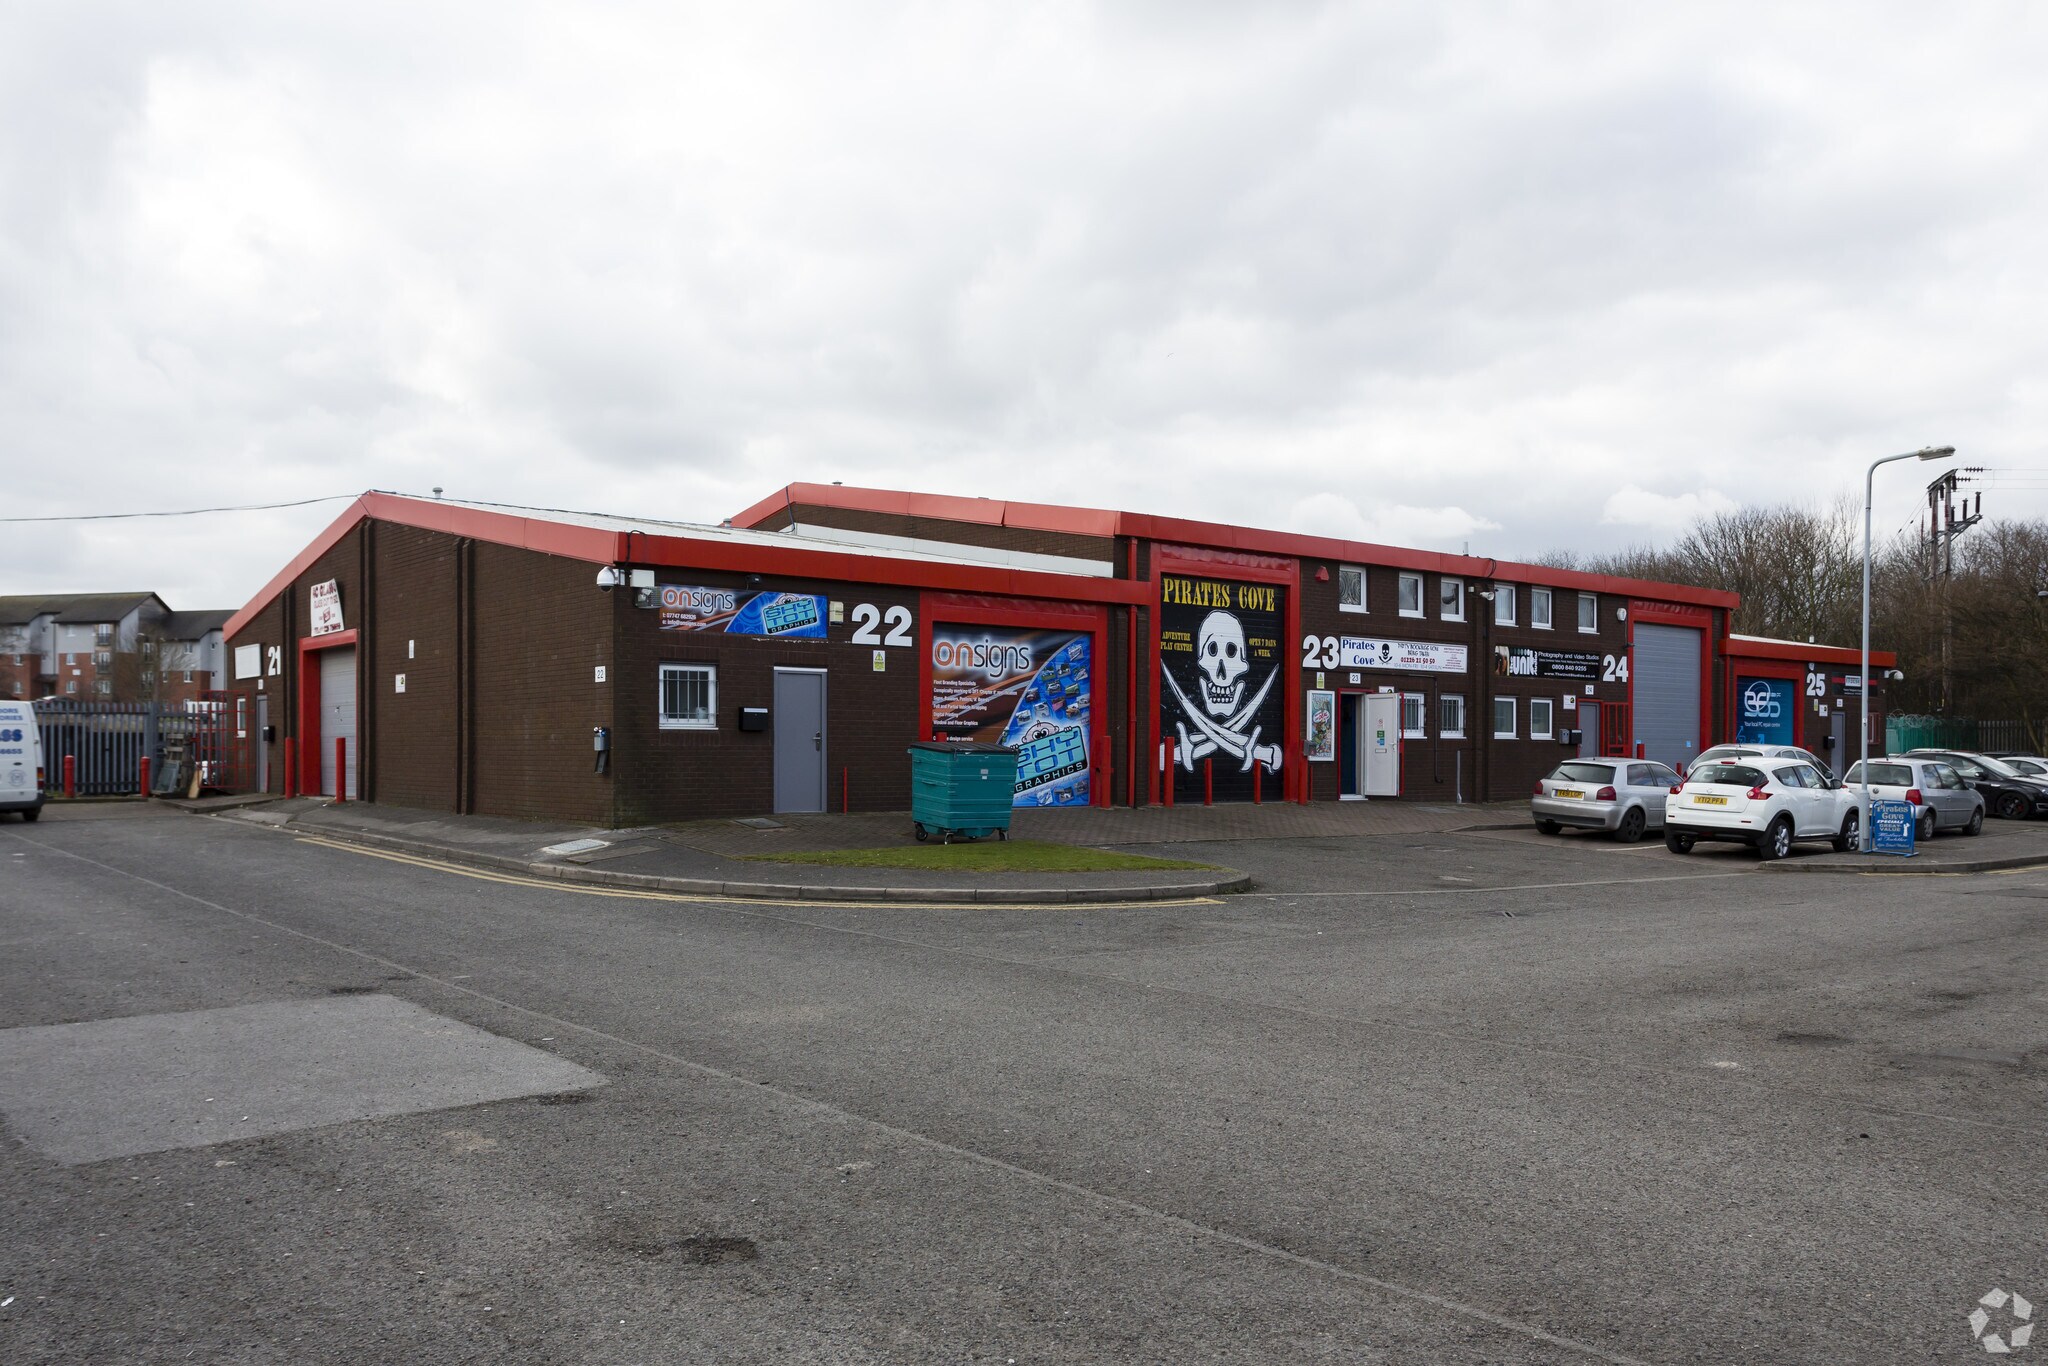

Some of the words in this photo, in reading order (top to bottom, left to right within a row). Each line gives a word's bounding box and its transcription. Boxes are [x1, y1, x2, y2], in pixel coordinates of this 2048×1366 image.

[664, 588, 733, 614] onsigns
[1163, 578, 1230, 608] PIRATES
[1238, 586, 1275, 612] COVE
[766, 599, 812, 616] SHY
[768, 610, 814, 626] TOT
[771, 618, 814, 633] GRAPHICS
[852, 603, 912, 647] 22
[1162, 631, 1191, 641] ADVENTURE
[1249, 638, 1261, 646] OPEN
[1342, 640, 1375, 650] Pirates
[1161, 642, 1173, 650] PLAY
[1174, 643, 1193, 652] CENTRE
[1302, 635, 1340, 670] 23
[268, 645, 280, 676] 21
[934, 639, 1029, 677] onsigns
[1354, 655, 1374, 666] Cove
[1603, 654, 1628, 682] 24
[597, 670, 603, 678] 22
[1806, 673, 1826, 696] 25
[1016, 762, 1083, 792] GRAPHICS
